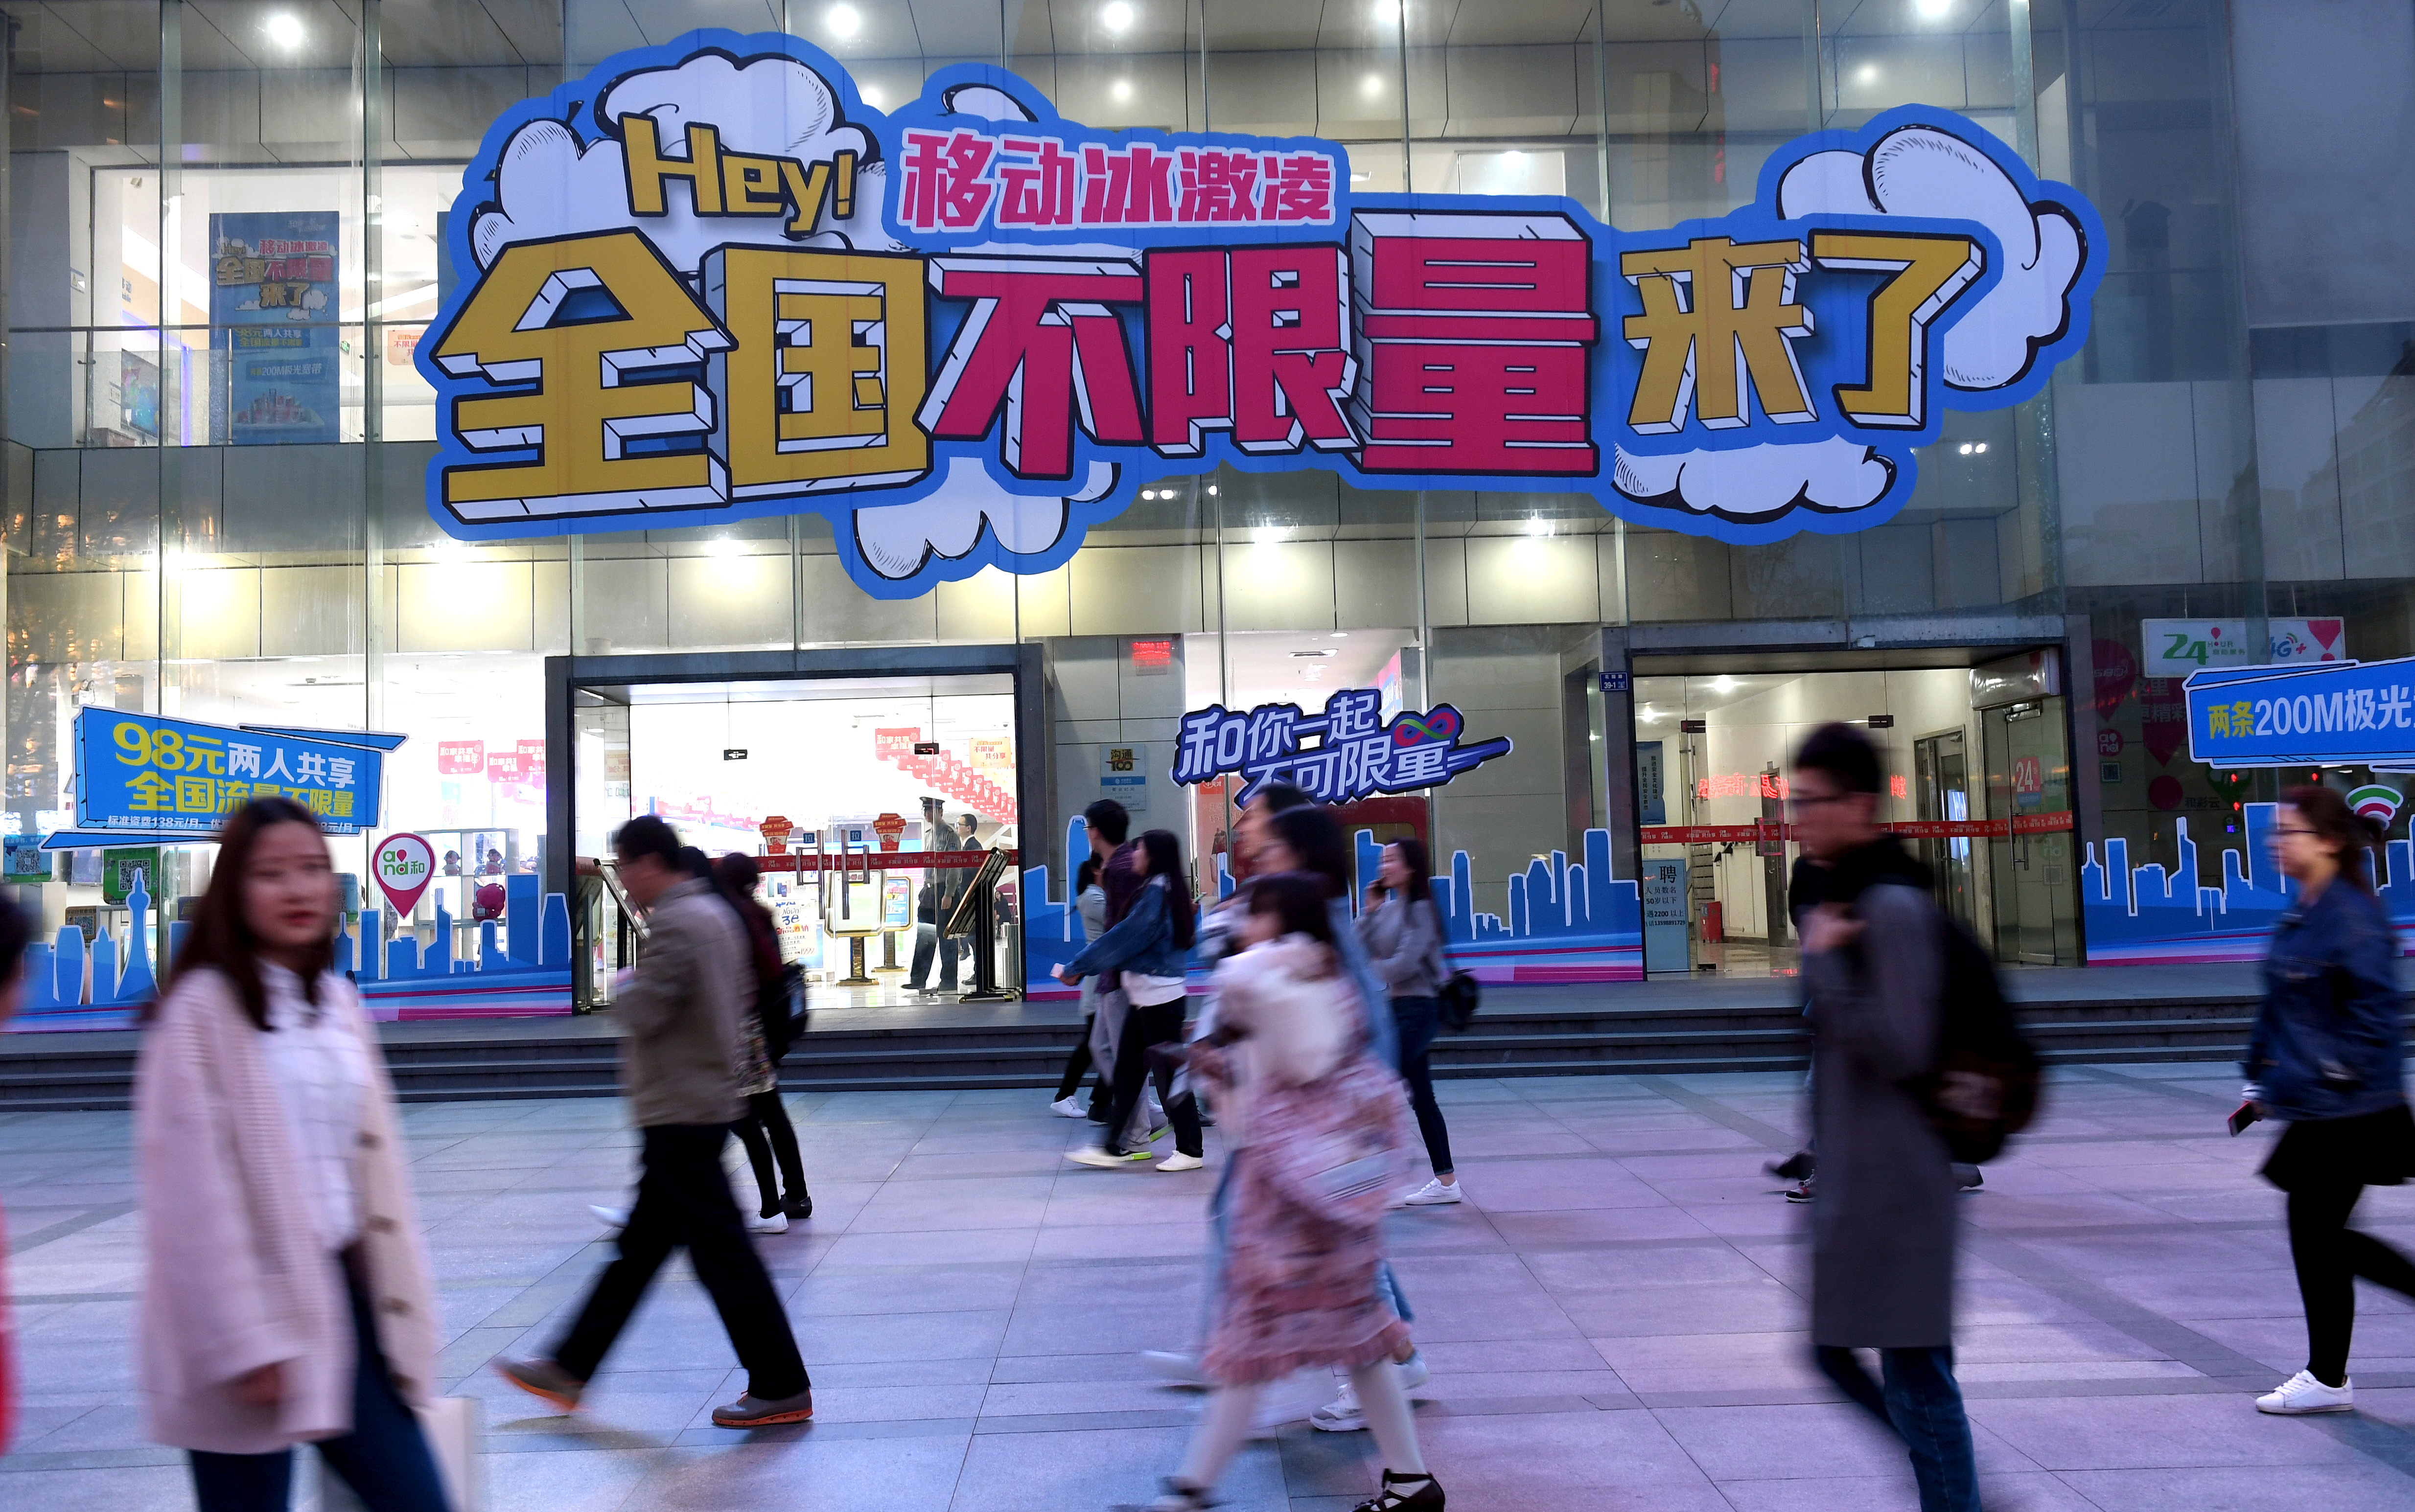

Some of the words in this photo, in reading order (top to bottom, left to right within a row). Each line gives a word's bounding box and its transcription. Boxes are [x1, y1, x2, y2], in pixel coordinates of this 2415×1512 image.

[619, 112, 857, 239] Hey!
[901, 130, 1332, 229] 移动冰激凌
[259, 281, 310, 307] 来了
[2162, 633, 2209, 665] 24
[2207, 684, 2415, 739] 两条200M极光
[113, 722, 355, 788] 98元两人共享
[1111, 749, 1132, 759] 沟通
[1178, 693, 1375, 778] 和你一起
[1242, 735, 1451, 801] 不可限量
[2017, 760, 2033, 792] 24
[411, 860, 425, 874] 和
[1659, 865, 1677, 884] 聘
